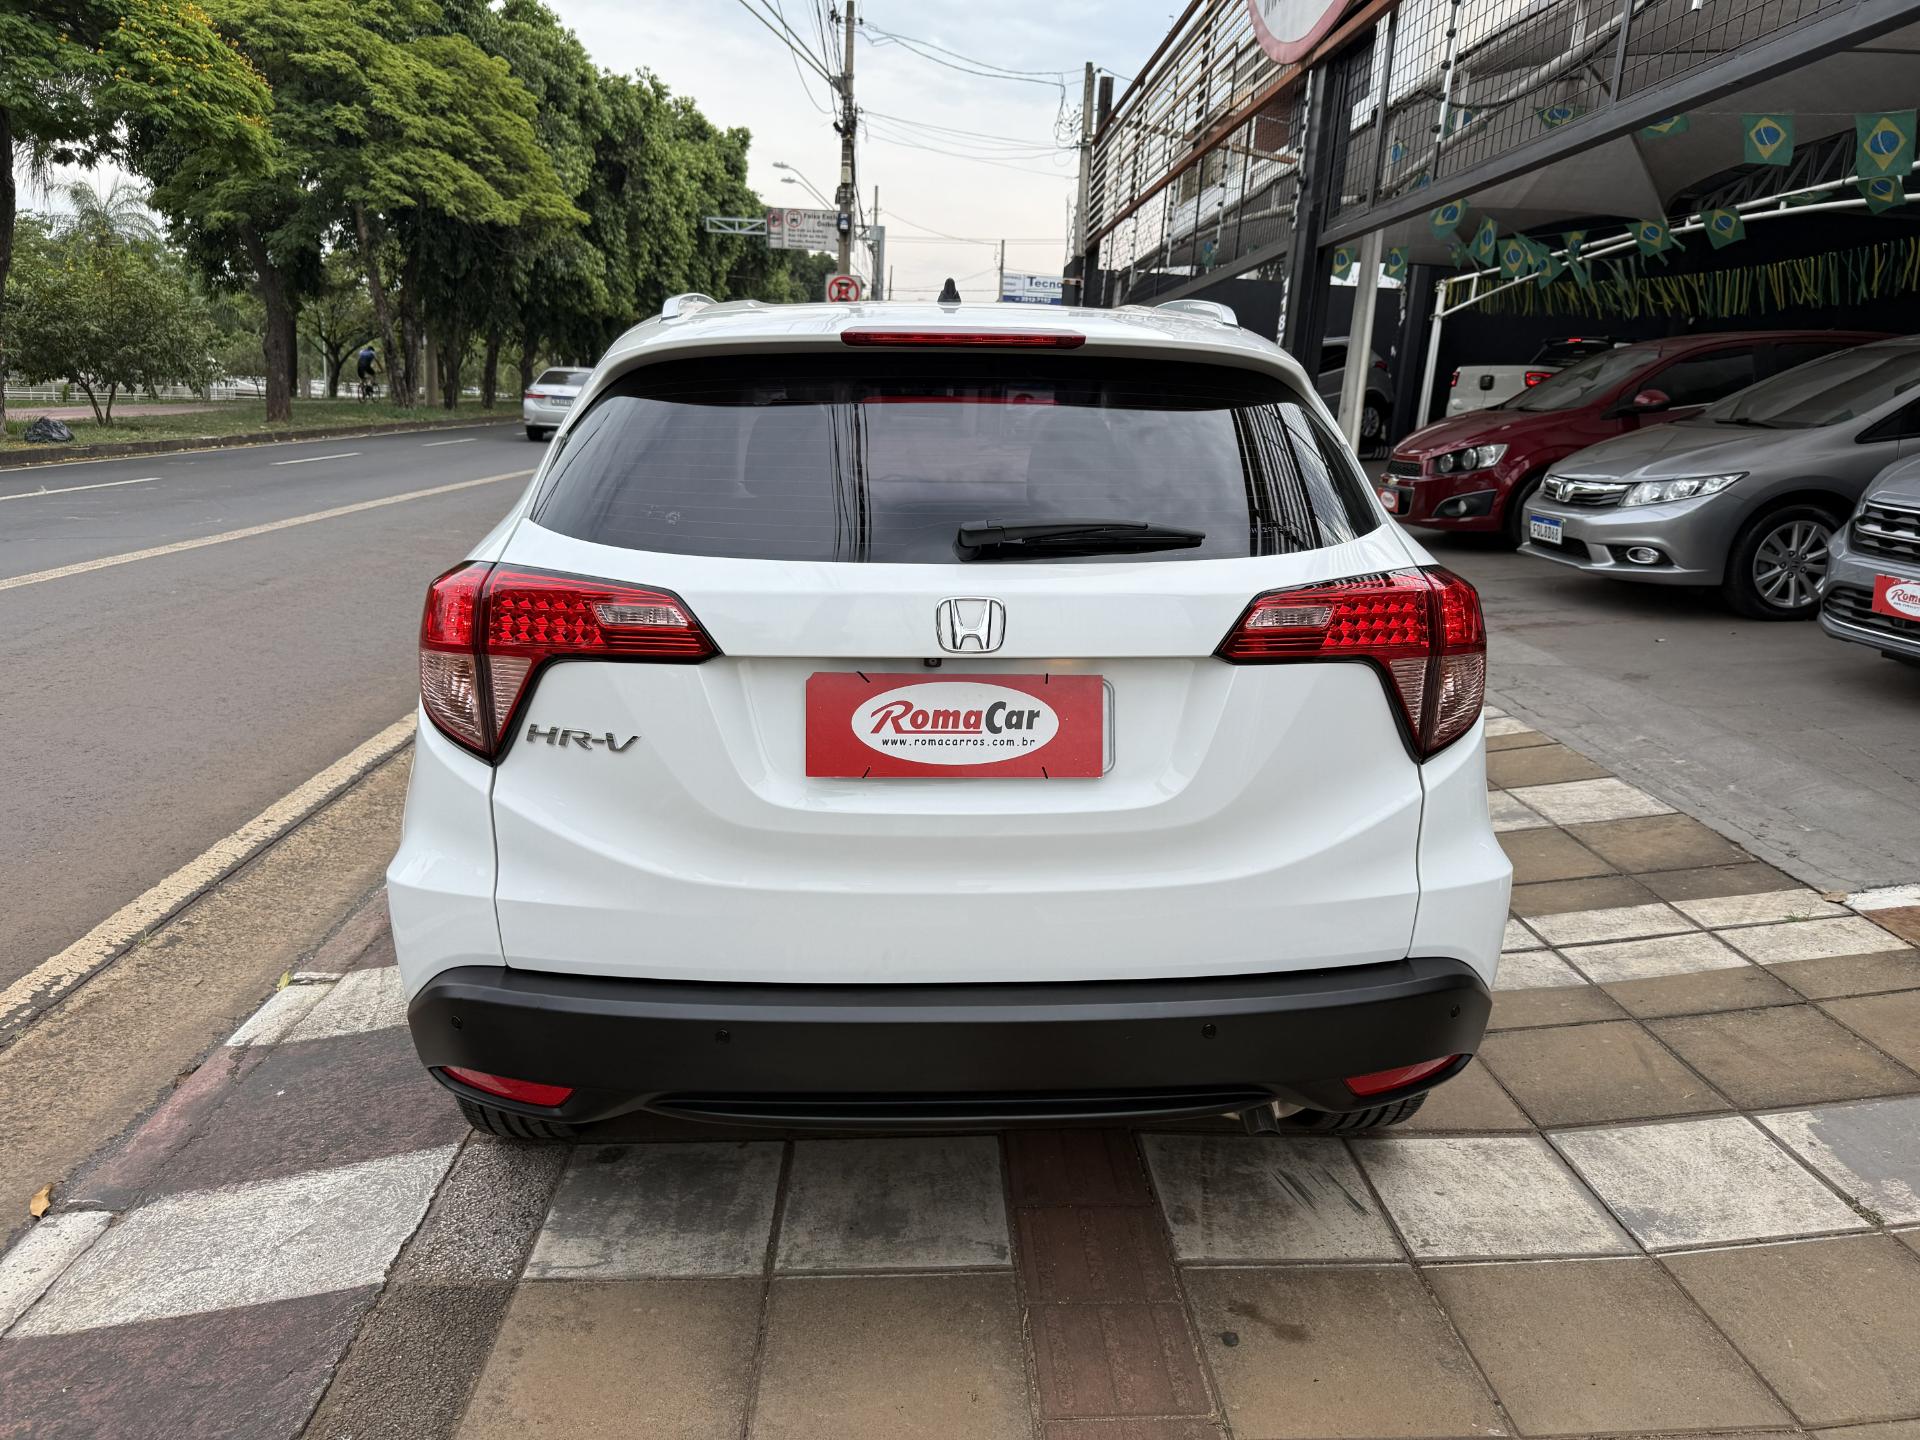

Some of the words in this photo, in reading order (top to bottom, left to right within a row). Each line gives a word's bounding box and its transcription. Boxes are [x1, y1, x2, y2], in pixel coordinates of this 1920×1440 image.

[1891, 589, 1920, 604] Rom
[870, 700, 1040, 735] RomaCar
[526, 723, 641, 752] HR-V
[881, 736, 1036, 747] www.romacarros.com.br
